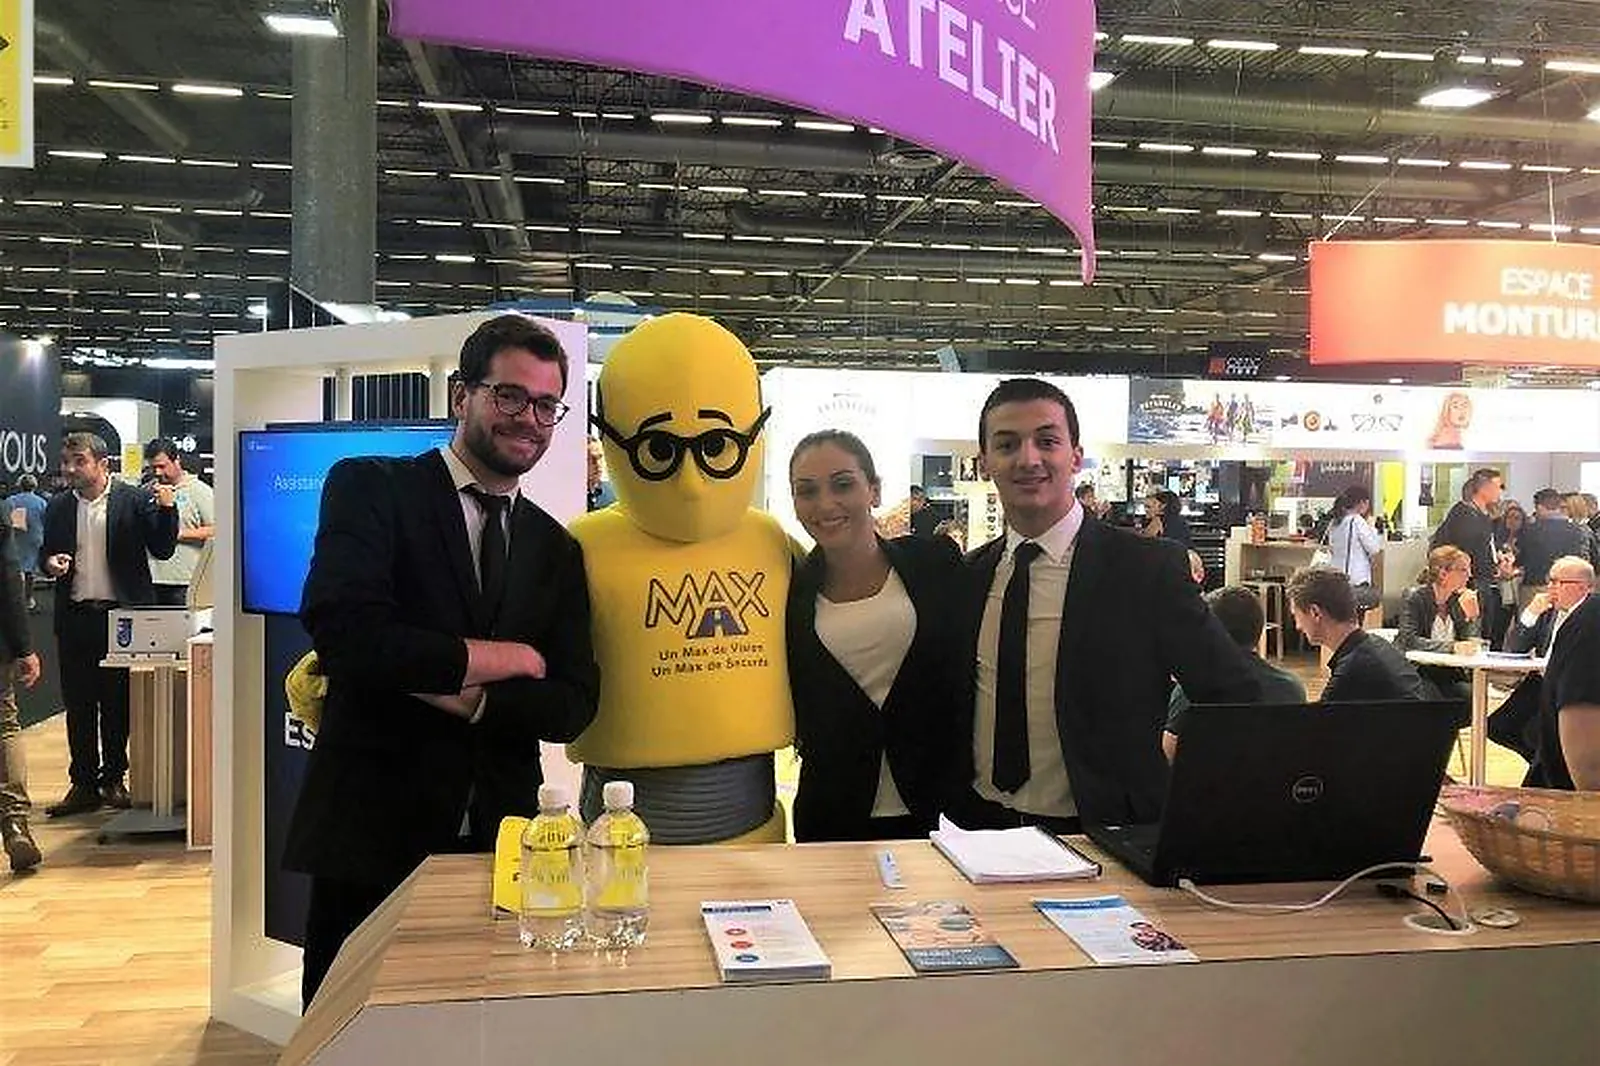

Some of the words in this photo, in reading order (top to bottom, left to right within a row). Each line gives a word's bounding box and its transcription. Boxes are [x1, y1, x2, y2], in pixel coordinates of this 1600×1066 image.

[843, 0, 1060, 155] ATELIER
[1501, 267, 1594, 300] ESPACE
[1444, 302, 1600, 342] MONTUR
[645, 570, 769, 640] MAX
[651, 665, 671, 678] Un
[675, 662, 703, 674] Max
[659, 649, 678, 661] Un
[682, 646, 708, 658] Max
